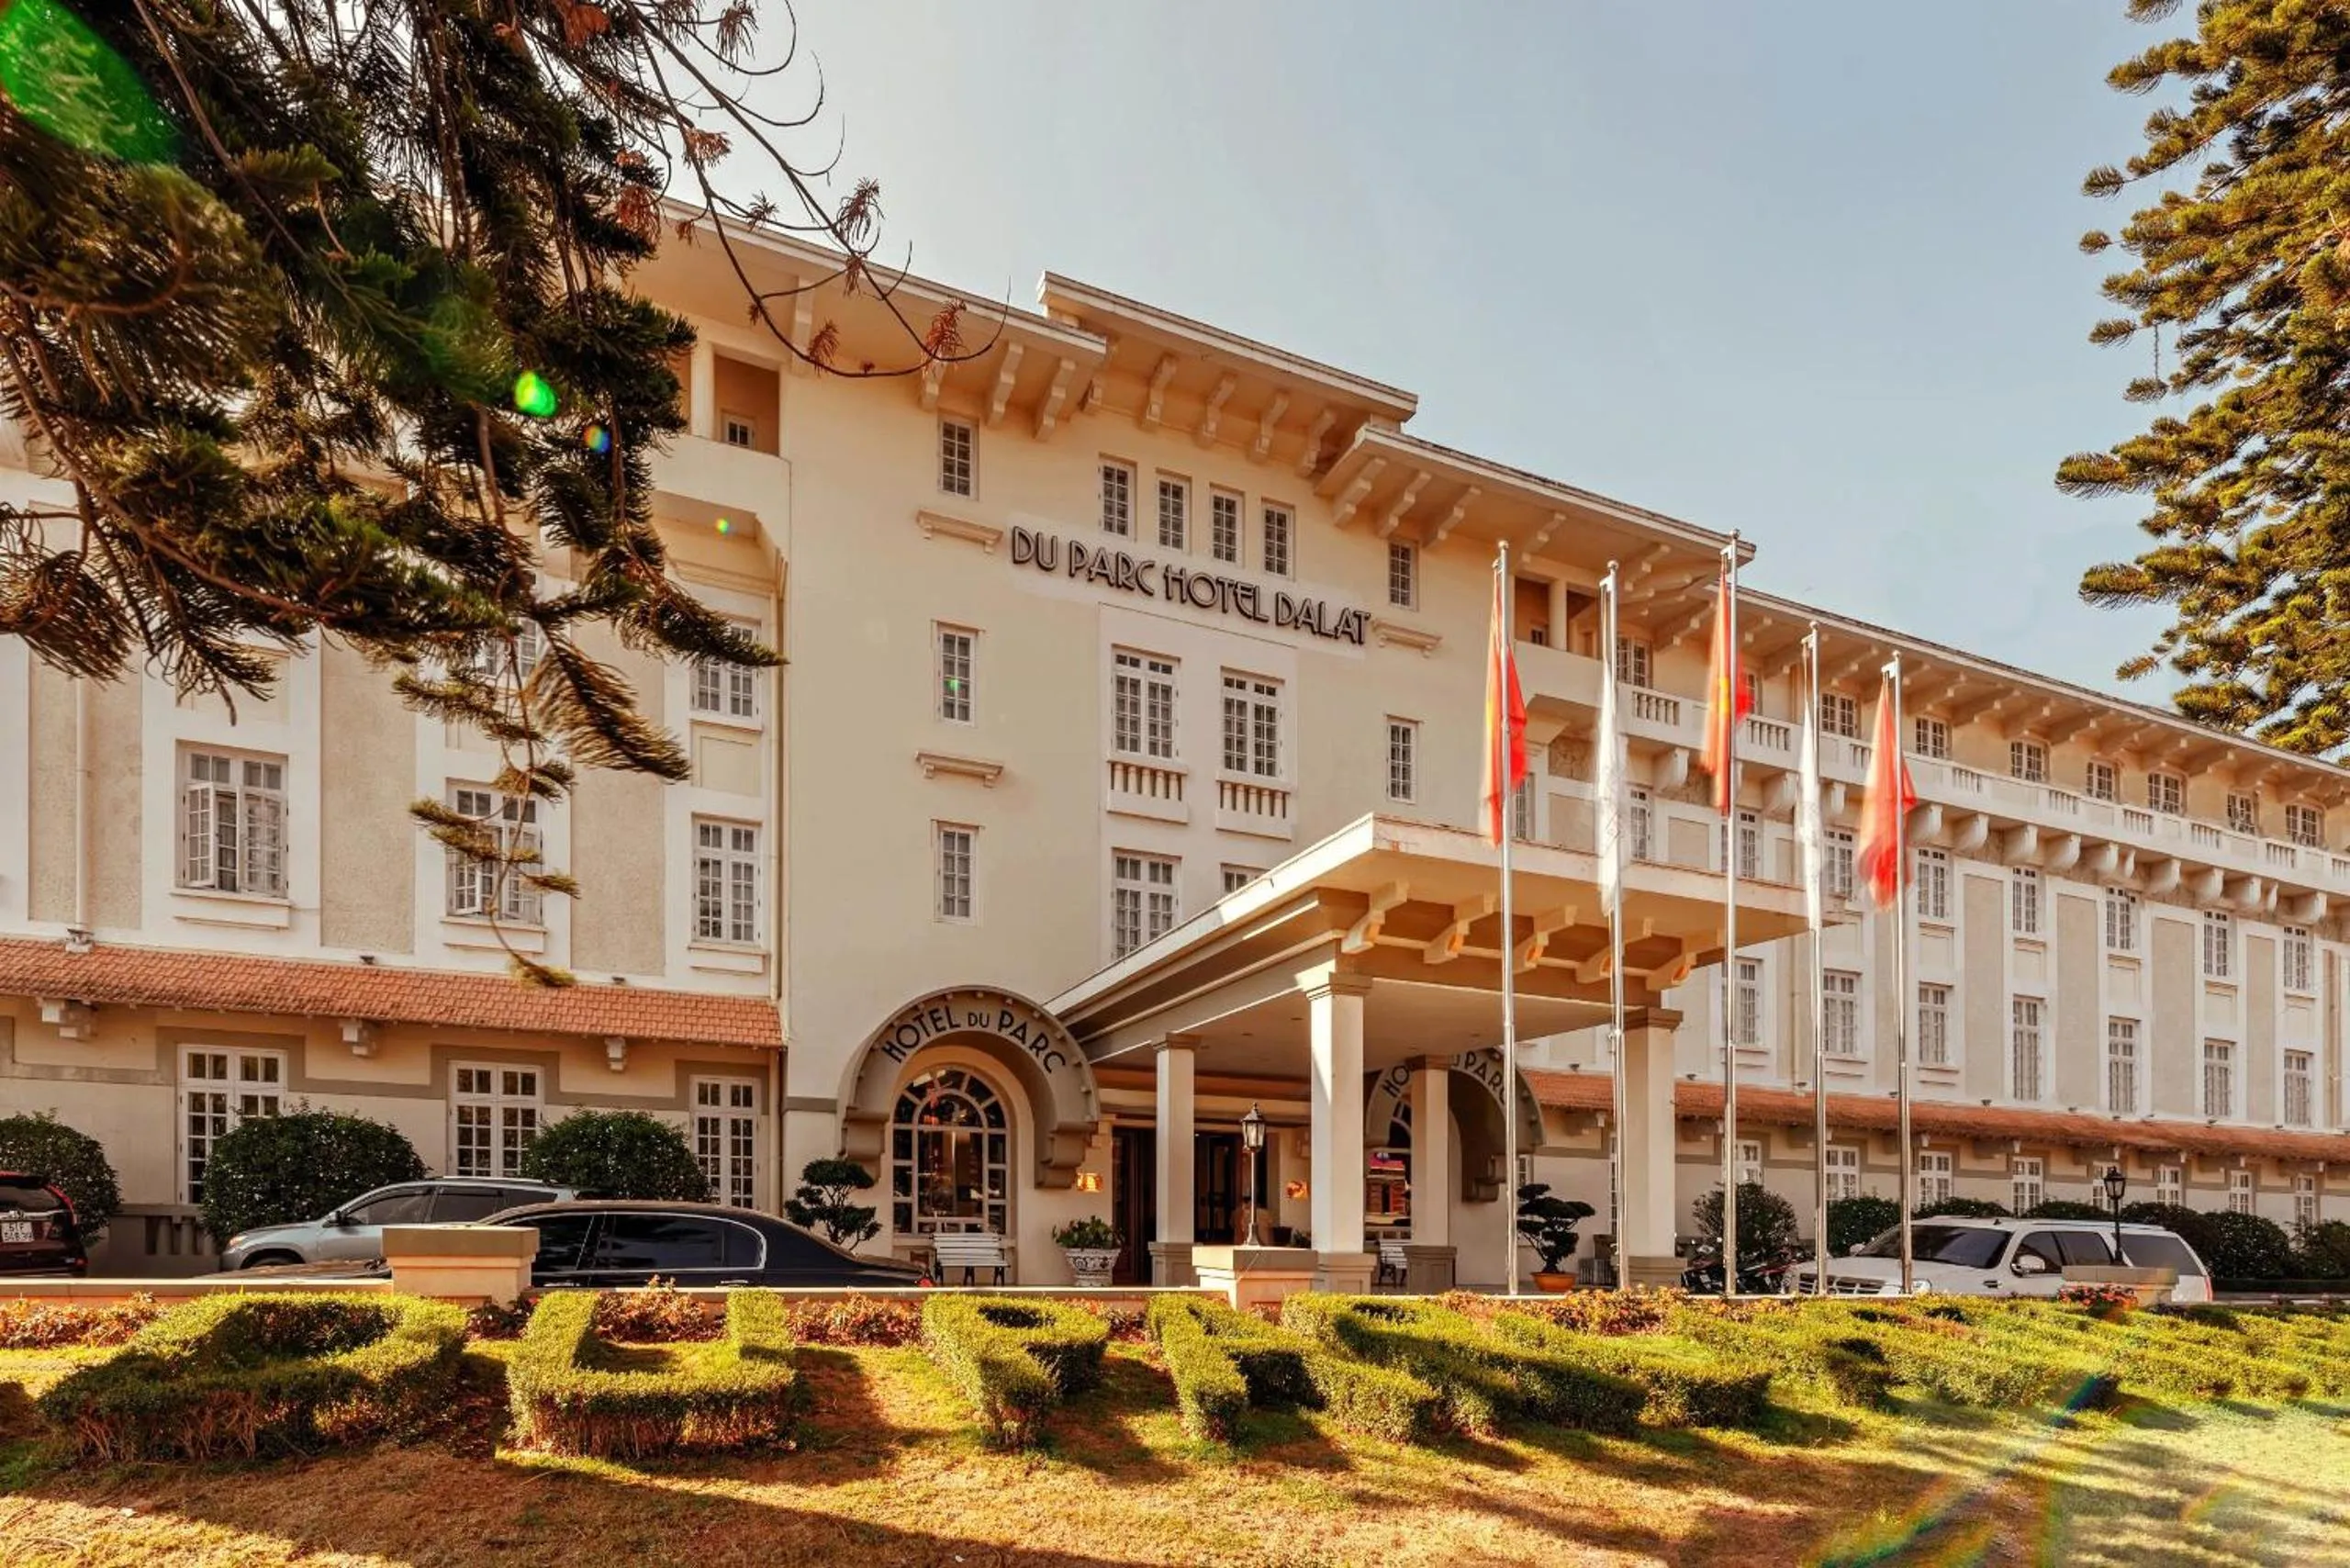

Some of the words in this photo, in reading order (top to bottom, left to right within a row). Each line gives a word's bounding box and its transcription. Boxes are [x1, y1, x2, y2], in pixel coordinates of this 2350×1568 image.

[1012, 525, 1058, 572] DU
[1069, 539, 1155, 596] PARC
[1163, 564, 1270, 623] HOTEL
[1274, 589, 1371, 644] DALAT
[881, 1006, 961, 1064] HOTEL
[968, 1012, 990, 1028] DU
[998, 1010, 1066, 1074] PARC
